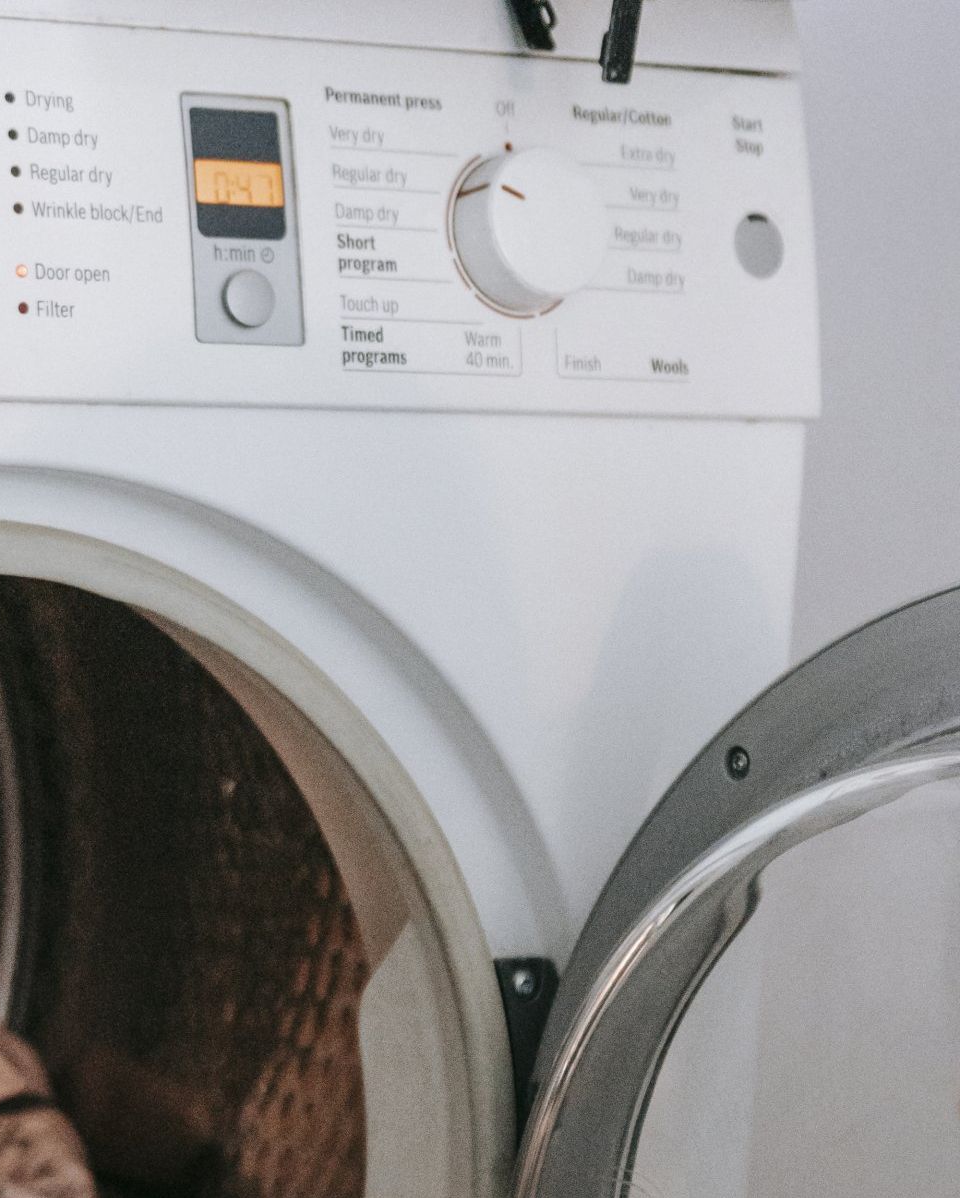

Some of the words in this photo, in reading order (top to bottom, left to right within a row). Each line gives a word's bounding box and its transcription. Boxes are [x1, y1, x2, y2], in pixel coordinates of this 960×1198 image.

[25, 90, 73, 112] Drying
[325, 87, 400, 107] Permanent
[406, 95, 442, 111] press
[573, 105, 672, 126] Regular/Cotton
[28, 128, 70, 148] Damp
[74, 131, 98, 150] dry
[330, 126, 358, 146] Very
[363, 128, 384, 146] dry
[736, 138, 763, 156] Stop
[655, 148, 675, 165] dry
[30, 164, 84, 184] Regular
[88, 167, 112, 186] dry
[332, 164, 381, 183] Regular
[386, 167, 407, 186] dry
[630, 187, 655, 205] Very
[659, 190, 679, 207] dry
[32, 201, 86, 220] Wrinkle
[91, 204, 163, 224] block/End
[336, 203, 374, 223] Damp
[378, 206, 399, 224] dry
[338, 234, 375, 250] Short
[614, 228, 659, 245] Regular
[662, 229, 682, 246] dry
[214, 246, 256, 262] h:min
[35, 264, 70, 281] Door
[74, 268, 110, 284] open
[339, 257, 397, 273] program
[628, 268, 662, 285] Damp
[666, 271, 685, 288] dry
[37, 301, 74, 318] Filter
[340, 295, 378, 312] Touch
[383, 299, 398, 314] up
[342, 326, 384, 343] Timed
[465, 331, 501, 346] Warm
[342, 349, 407, 367] programs
[466, 352, 483, 367] 40
[565, 355, 601, 371] Finish
[652, 358, 689, 375] Wools
